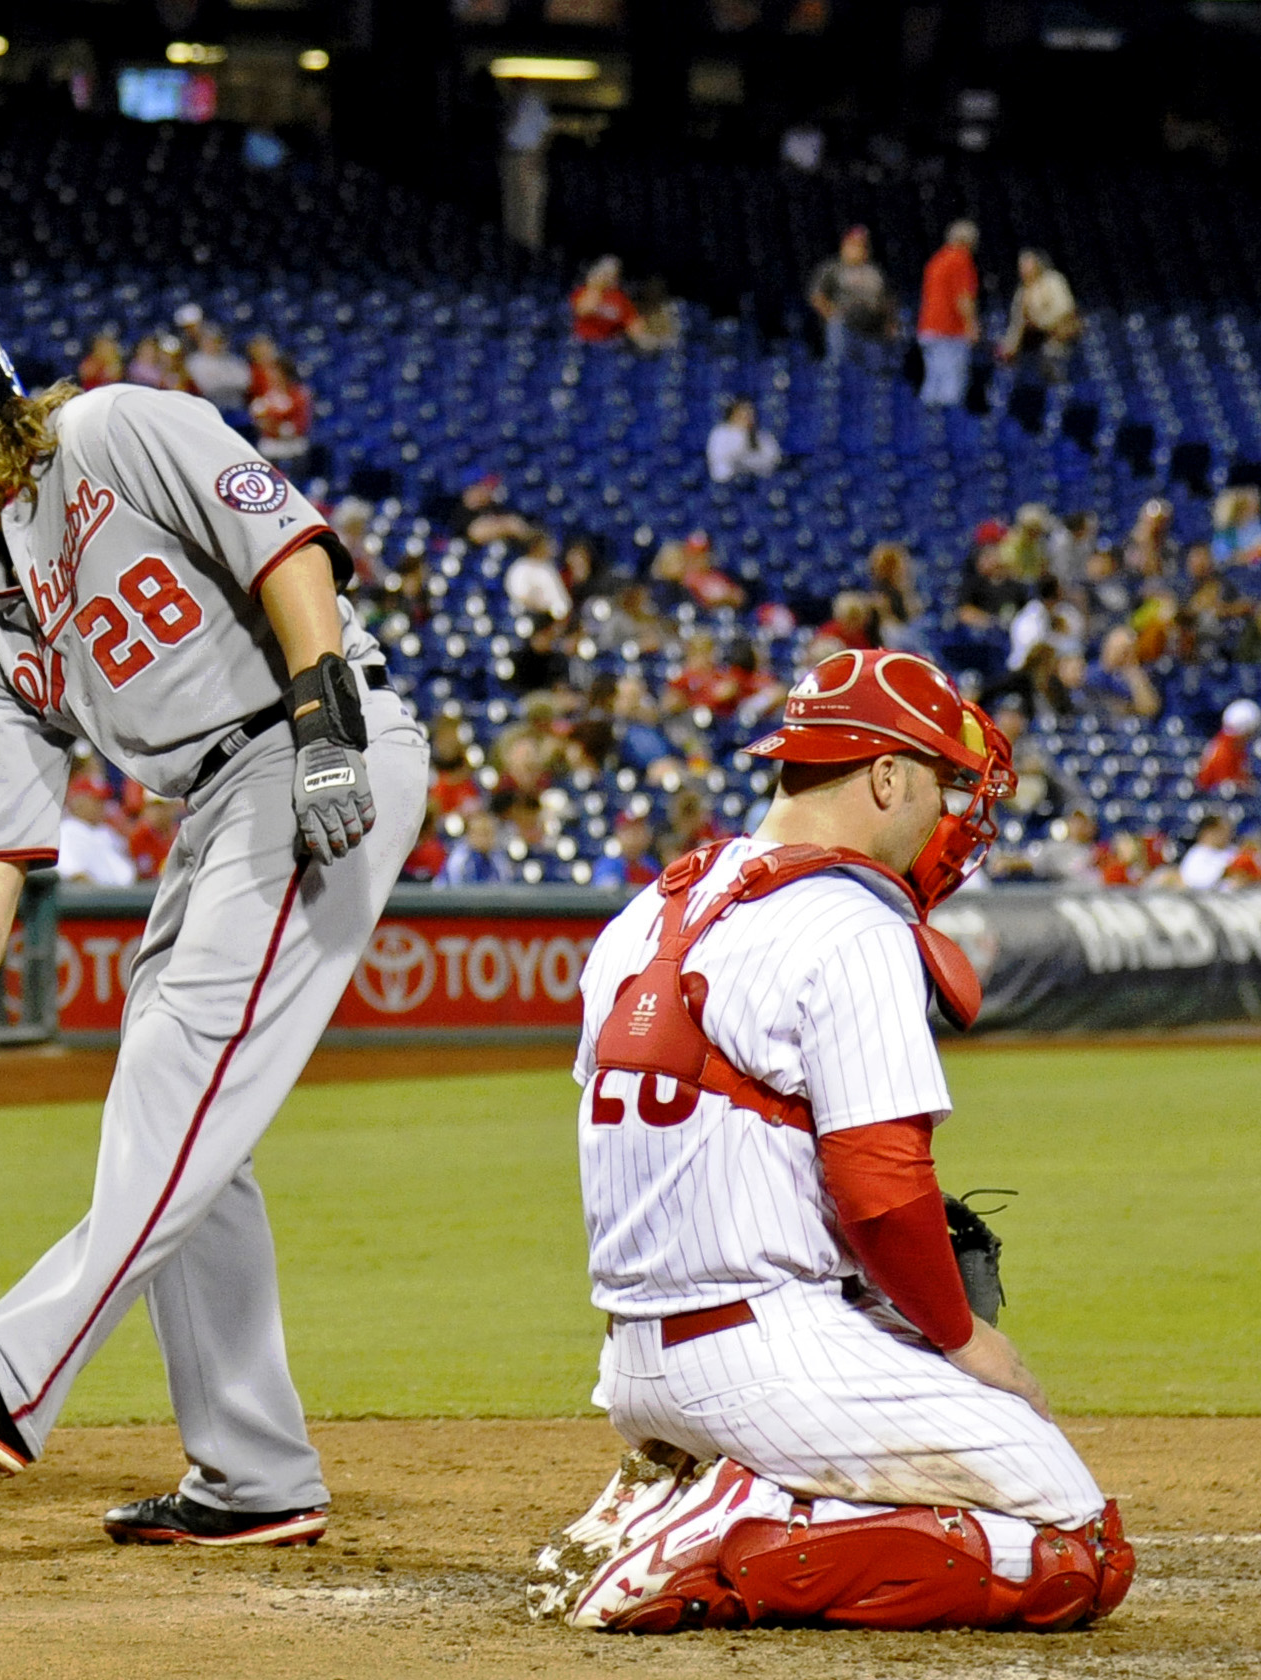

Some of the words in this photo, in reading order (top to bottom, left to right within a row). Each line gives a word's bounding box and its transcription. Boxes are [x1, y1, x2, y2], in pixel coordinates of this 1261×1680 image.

[218, 463, 271, 498] WASHINGTON
[240, 483, 286, 512] NATIONALS
[72, 555, 204, 692] 28
